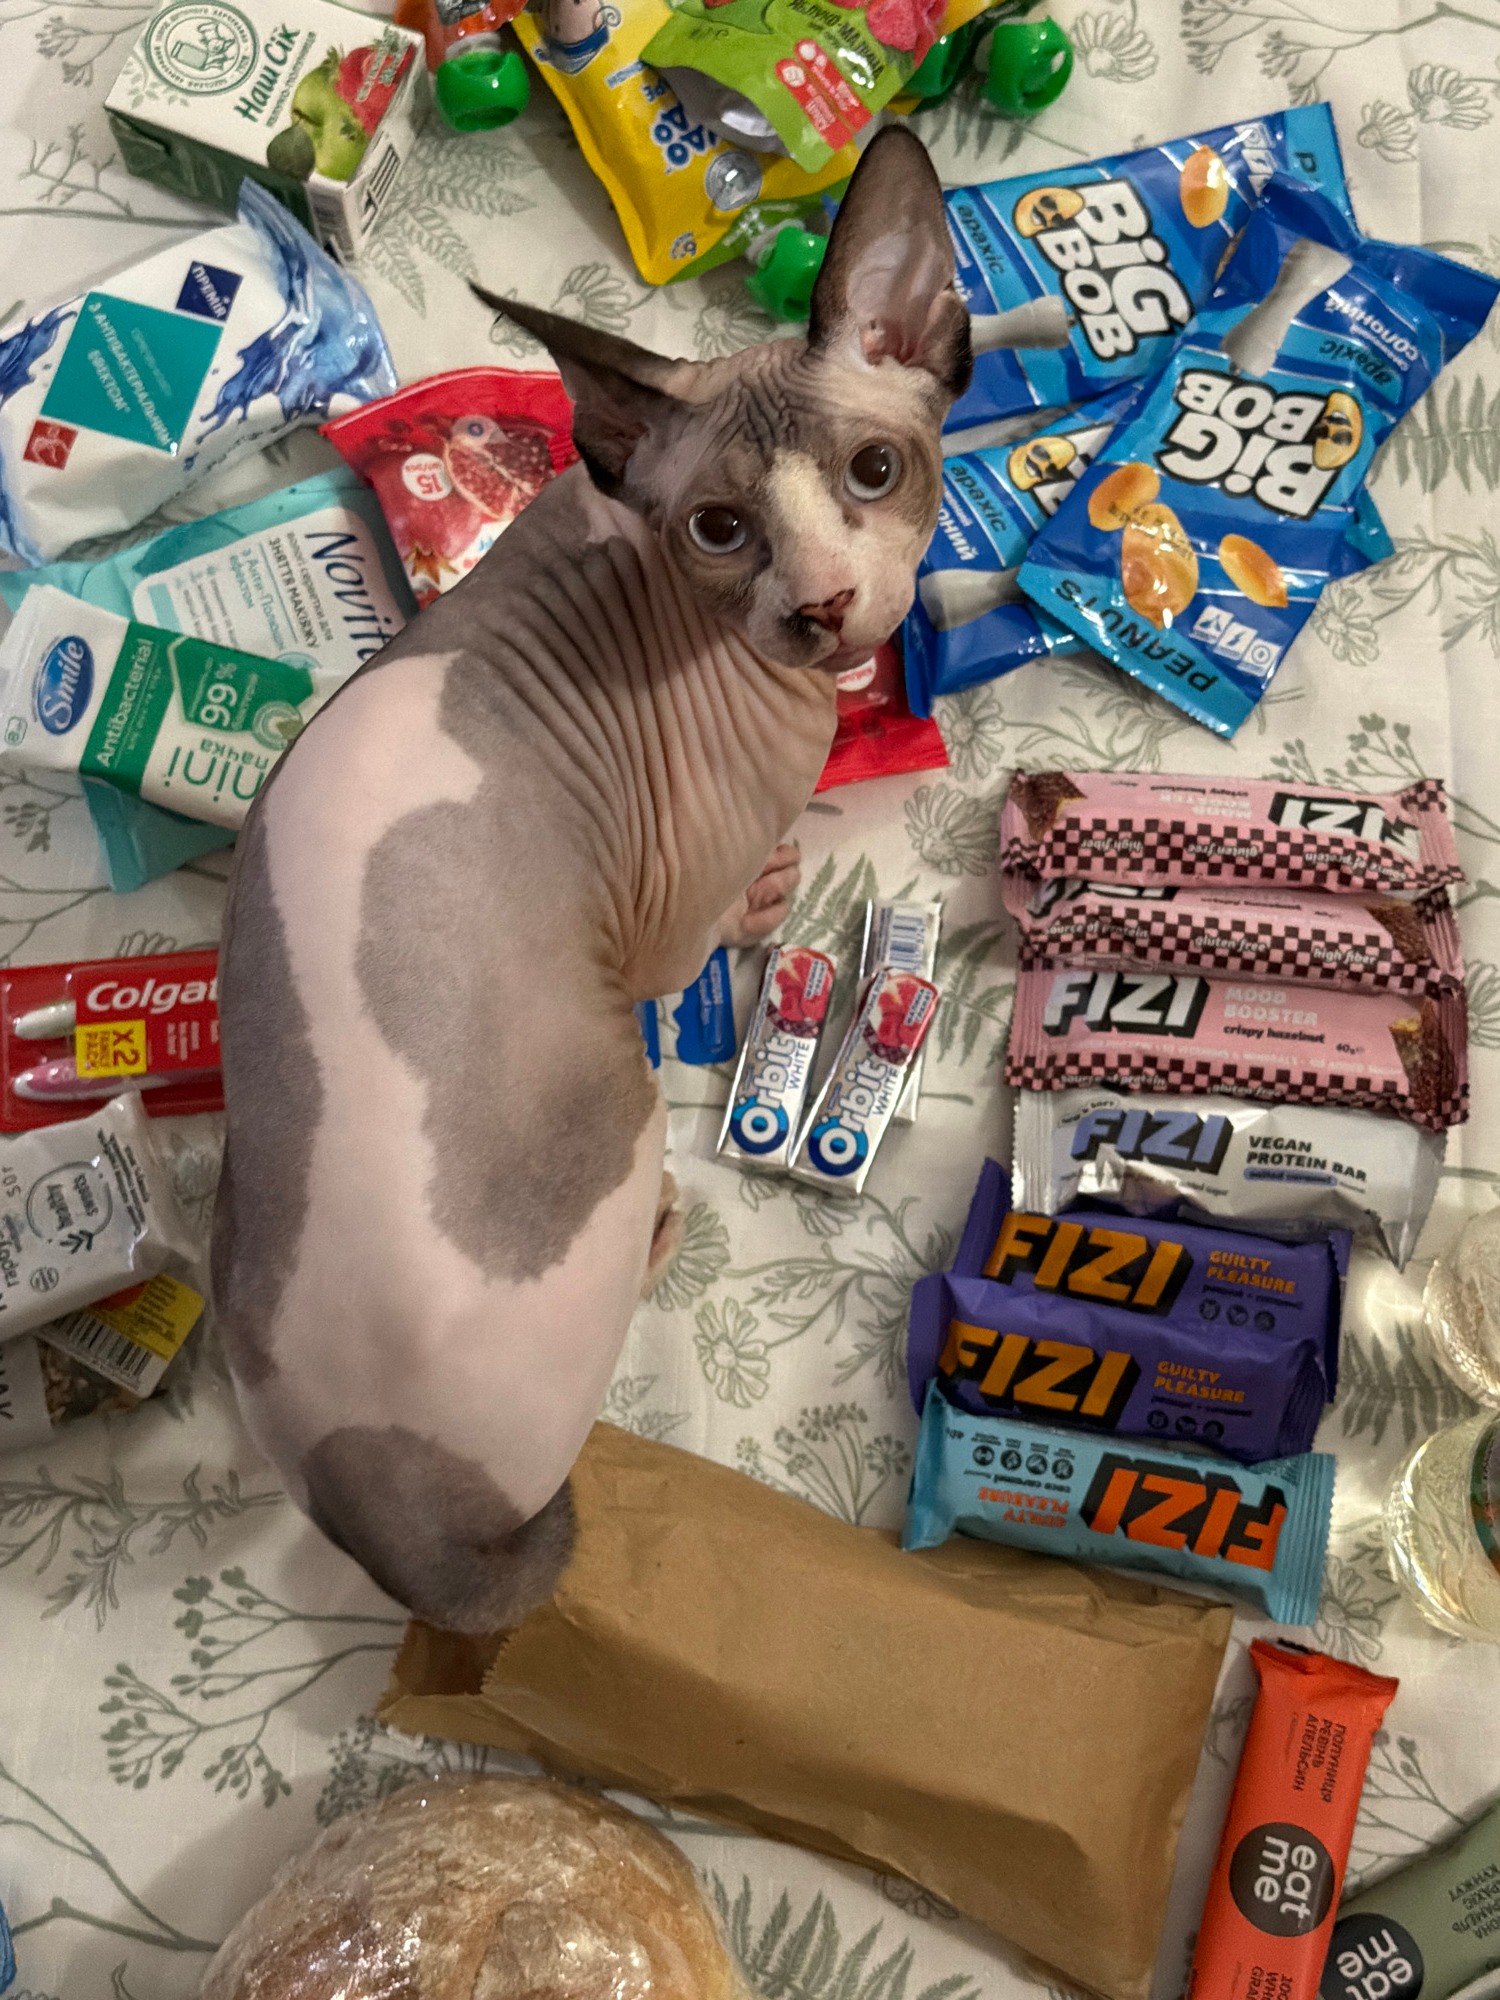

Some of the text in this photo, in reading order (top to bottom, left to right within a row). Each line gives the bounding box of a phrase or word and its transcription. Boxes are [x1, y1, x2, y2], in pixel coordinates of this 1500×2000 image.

[233, 23, 301, 122] Наш Сік
[1035, 229, 1134, 358] BOB
[1324, 289, 1419, 361] солоний
[1181, 373, 1323, 441] BOB
[416, 476, 444, 494] 15
[269, 537, 296, 584] ЗНЯТТЯ
[1056, 579, 1219, 692] PEANUTS
[42, 640, 85, 729] Smile
[95, 639, 155, 768] Antibacterial
[200, 738, 269, 771] пачка
[1081, 838, 1144, 853] high fiber
[1187, 842, 1259, 858] gluten free
[1304, 852, 1351, 867] protein
[1086, 921, 1100, 937] of
[1100, 923, 1149, 939] protein
[1194, 935, 1269, 954] gluten free
[1313, 947, 1378, 965] high fiber
[86, 978, 218, 1014] Colgat
[1042, 973, 1203, 1028] FIZI
[1223, 1004, 1318, 1026] BOOSTER
[1226, 988, 1288, 1004] MOOD
[1223, 1024, 1326, 1045] crispy hazelnut
[740, 1035, 797, 1143] Orbit
[787, 1043, 810, 1089] WHITE
[820, 1057, 888, 1158] Orbit
[872, 1069, 899, 1115] WHITE
[1071, 1109, 1226, 1164] FIZI
[1248, 1136, 1312, 1153] VEGAN
[1246, 1151, 1367, 1182] PROTEIN BAR
[983, 1213, 1184, 1307] FIZI
[1206, 1266, 1297, 1294] PLEASURE
[1209, 1250, 1272, 1272] GUILTY
[940, 1320, 1132, 1417] FIZI
[1153, 1375, 1246, 1403] PLEASURE
[1157, 1360, 1221, 1383] GUILTY
[978, 1487, 1069, 1512] PLEASURE
[994, 1475, 1042, 1490] caramel
[1002, 1509, 1067, 1528] GUILTY
[1089, 1468, 1288, 1571] FIZI
[1294, 1713, 1318, 1792] АПЕЛЬСИН
[1322, 1723, 1347, 1803] ПОЛУНИЦЯ
[1254, 1835, 1291, 1902] me
[1281, 1844, 1317, 1920] eat
[1336, 1929, 1400, 1978] me
